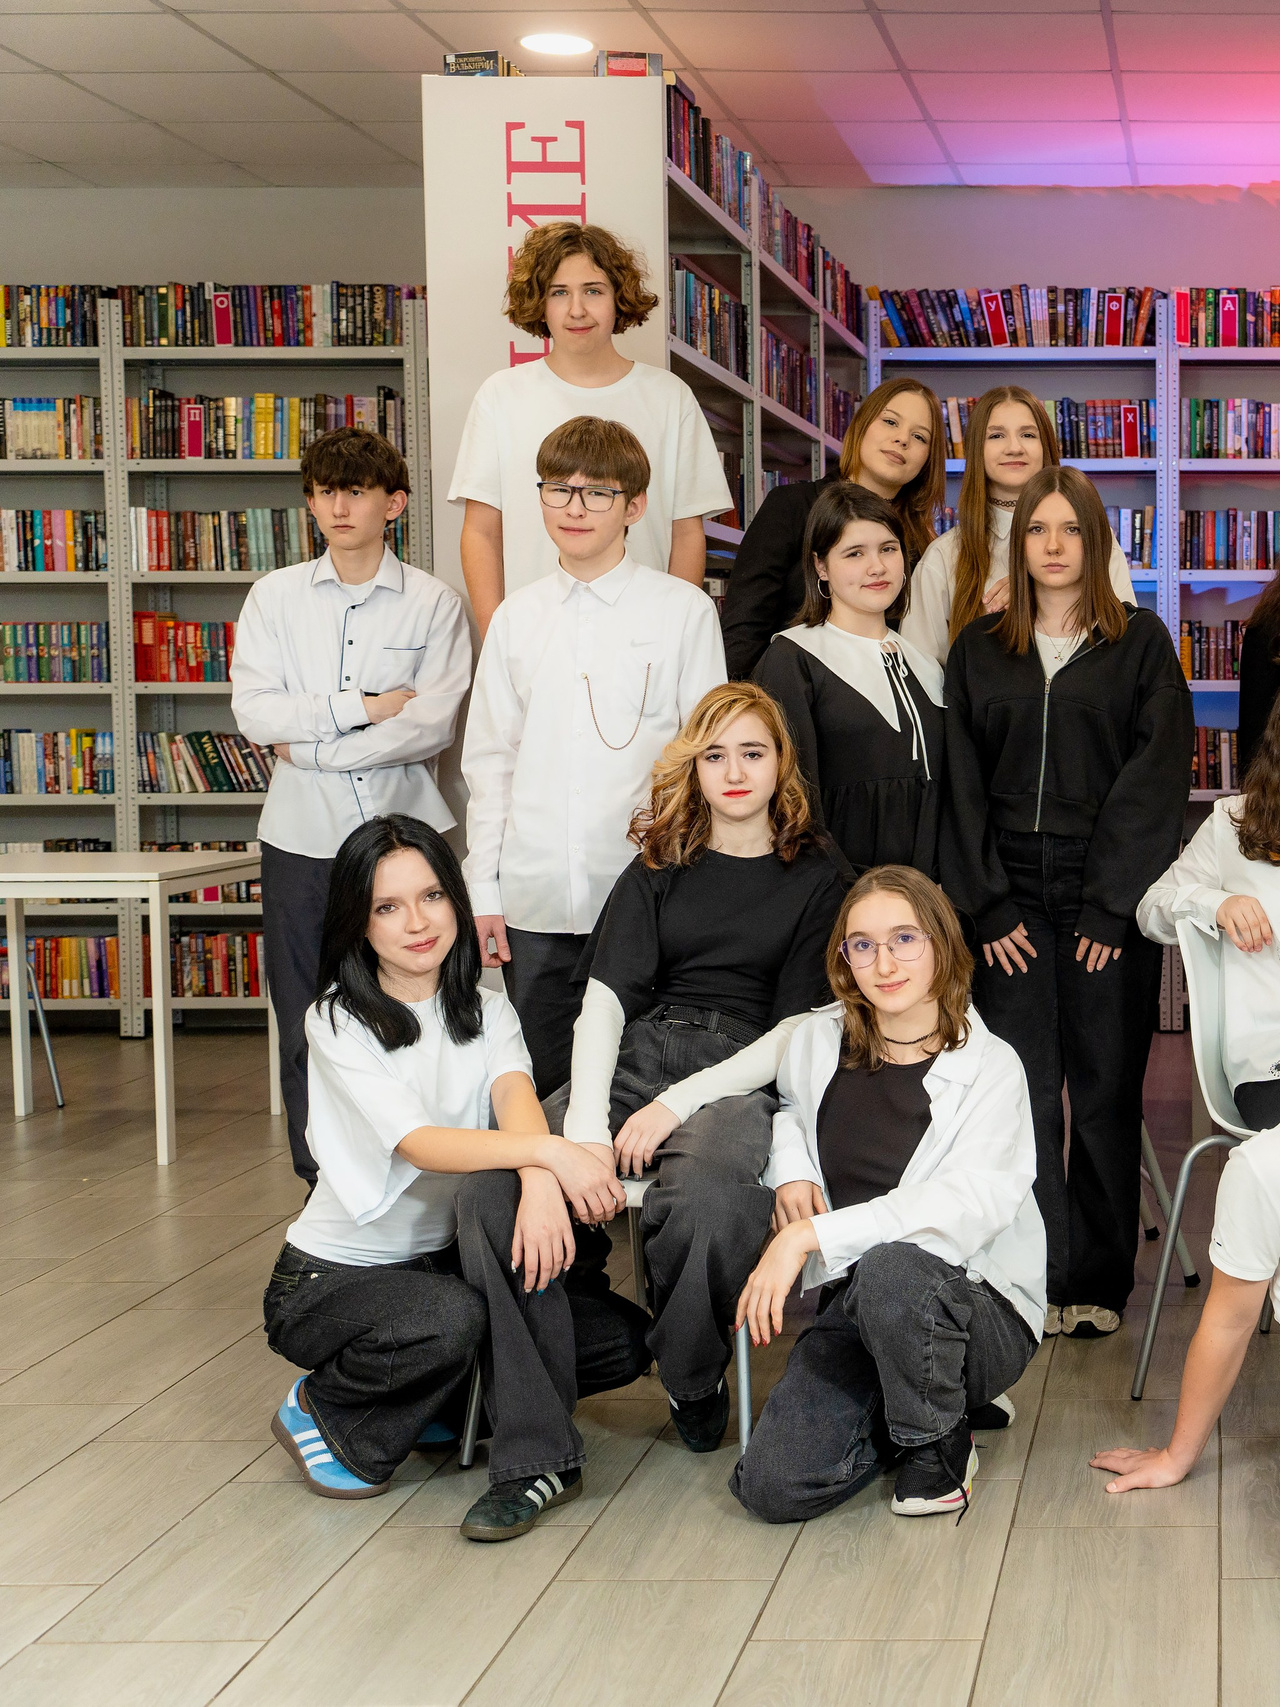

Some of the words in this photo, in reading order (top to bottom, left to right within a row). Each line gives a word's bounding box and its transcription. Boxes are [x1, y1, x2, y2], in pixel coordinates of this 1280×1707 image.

[1109, 300, 1120, 311] Ф
[1223, 299, 1235, 310] А
[1126, 412, 1135, 423] Х
